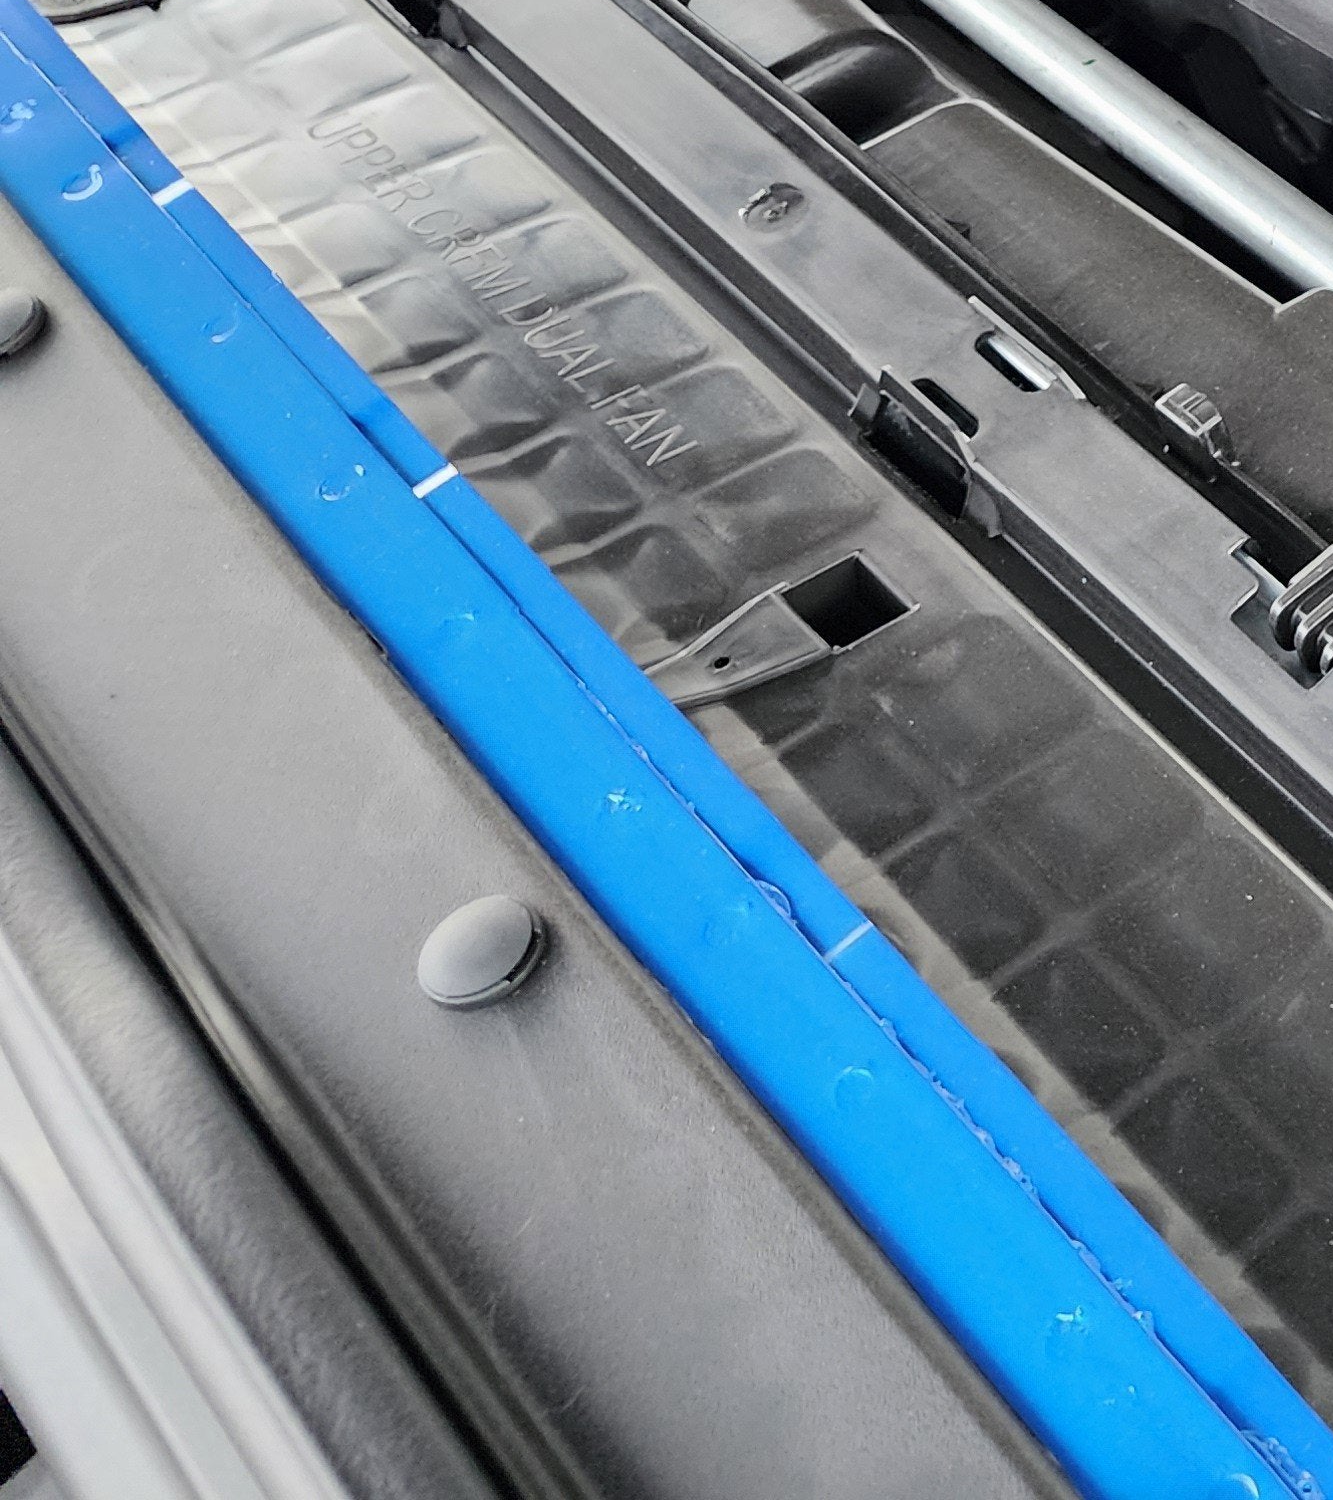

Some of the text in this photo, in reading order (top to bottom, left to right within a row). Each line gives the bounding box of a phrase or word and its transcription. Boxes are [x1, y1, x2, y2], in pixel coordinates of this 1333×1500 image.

[306, 120, 699, 468] UPPER CRFM DUAL FAN
